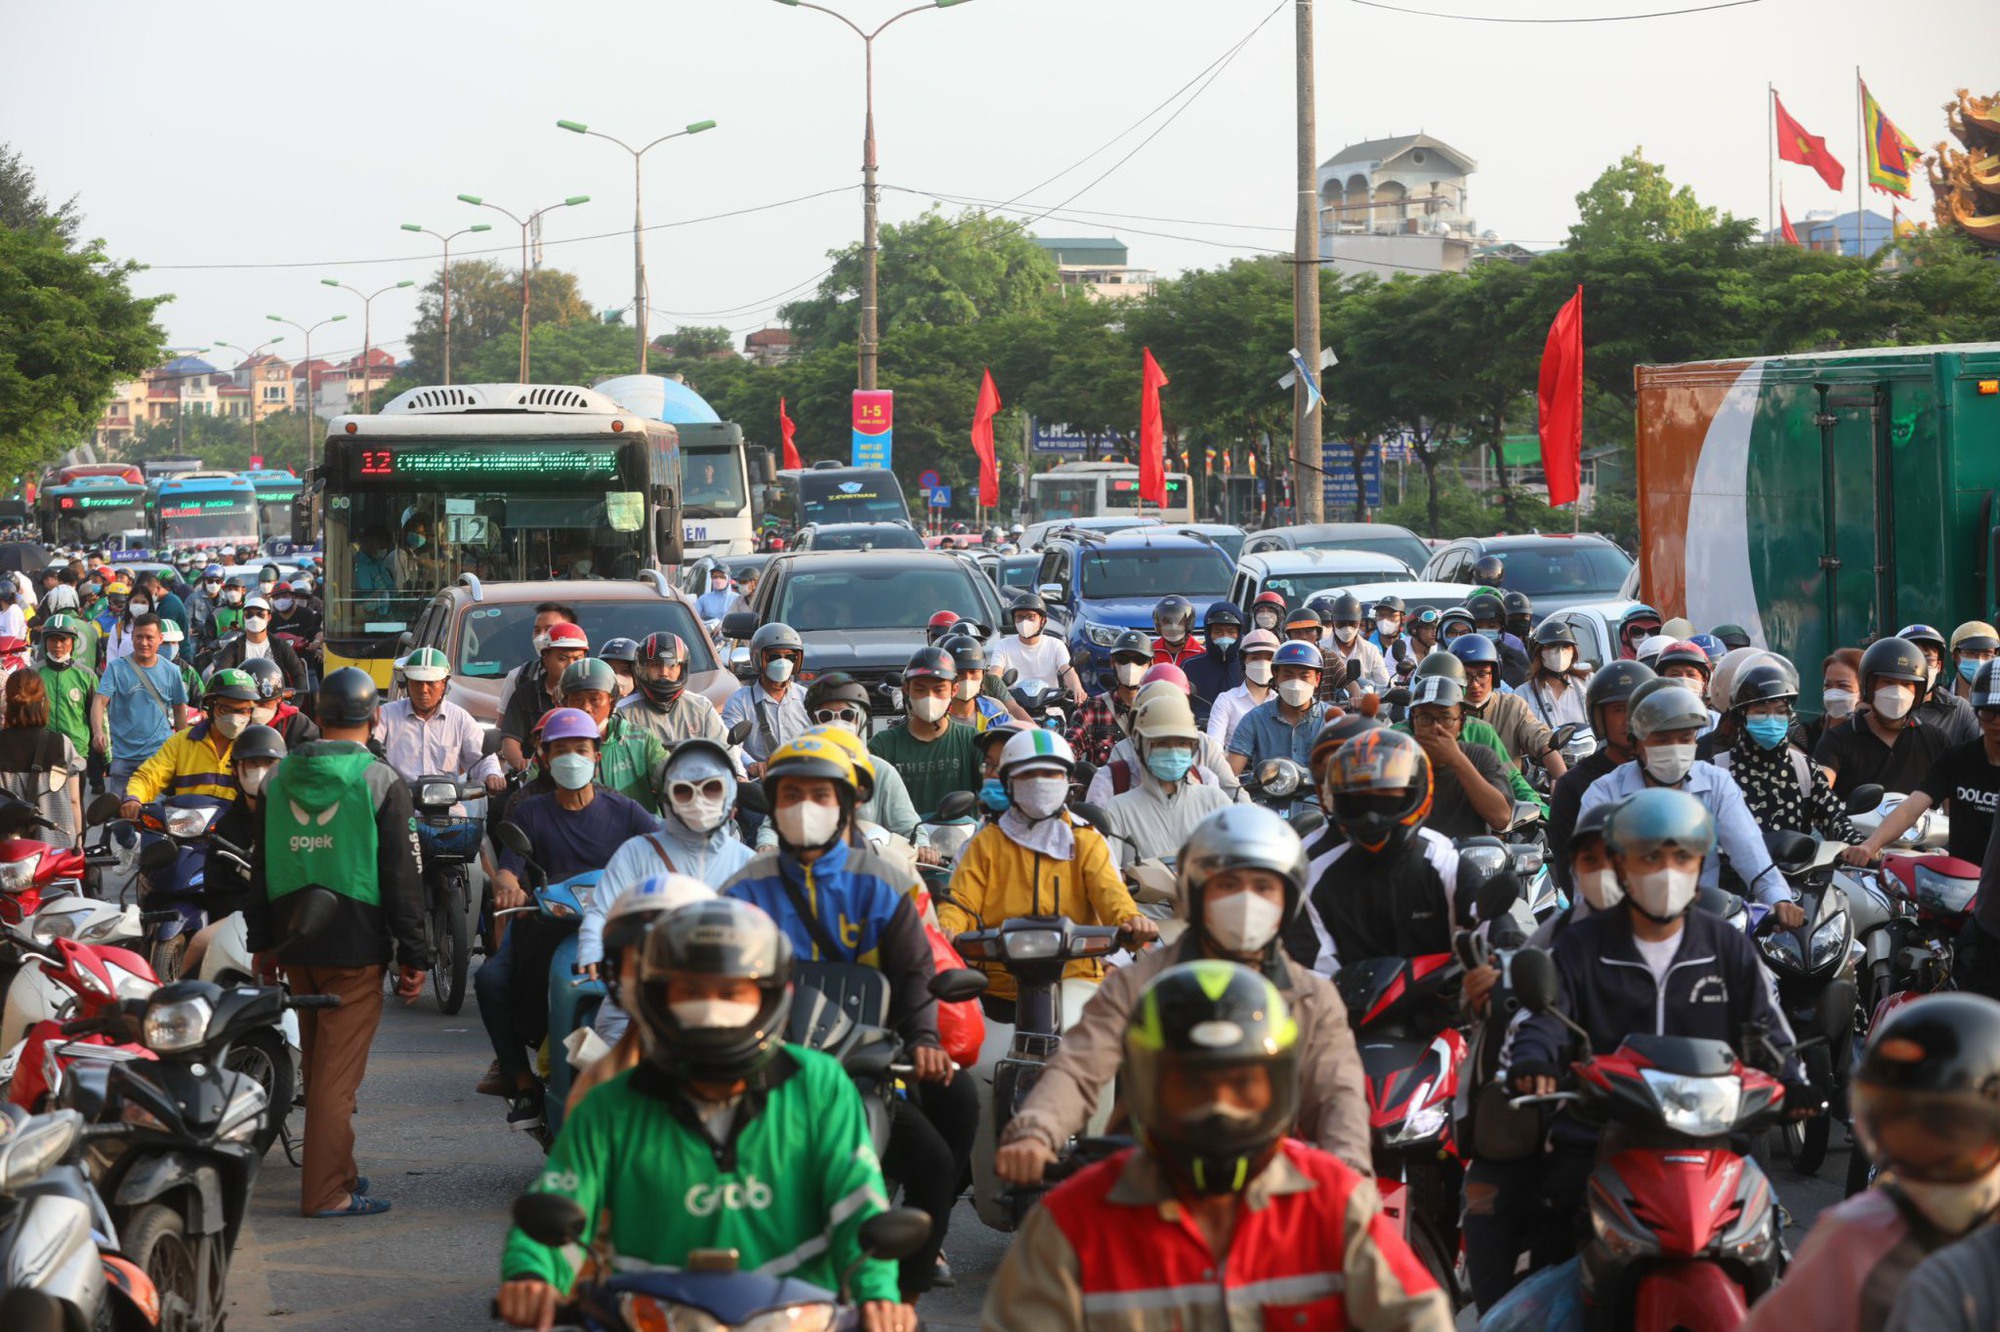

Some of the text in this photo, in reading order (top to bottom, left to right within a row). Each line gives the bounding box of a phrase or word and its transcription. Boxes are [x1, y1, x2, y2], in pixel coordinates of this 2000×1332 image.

[861, 404, 882, 418] 1-5
[361, 451, 392, 473] 12
[452, 517, 485, 543] 12
[895, 757, 961, 774] THERE'S
[1956, 785, 2000, 807] DOLCE
[289, 833, 334, 853] gojek
[683, 1173, 774, 1218] Grab
